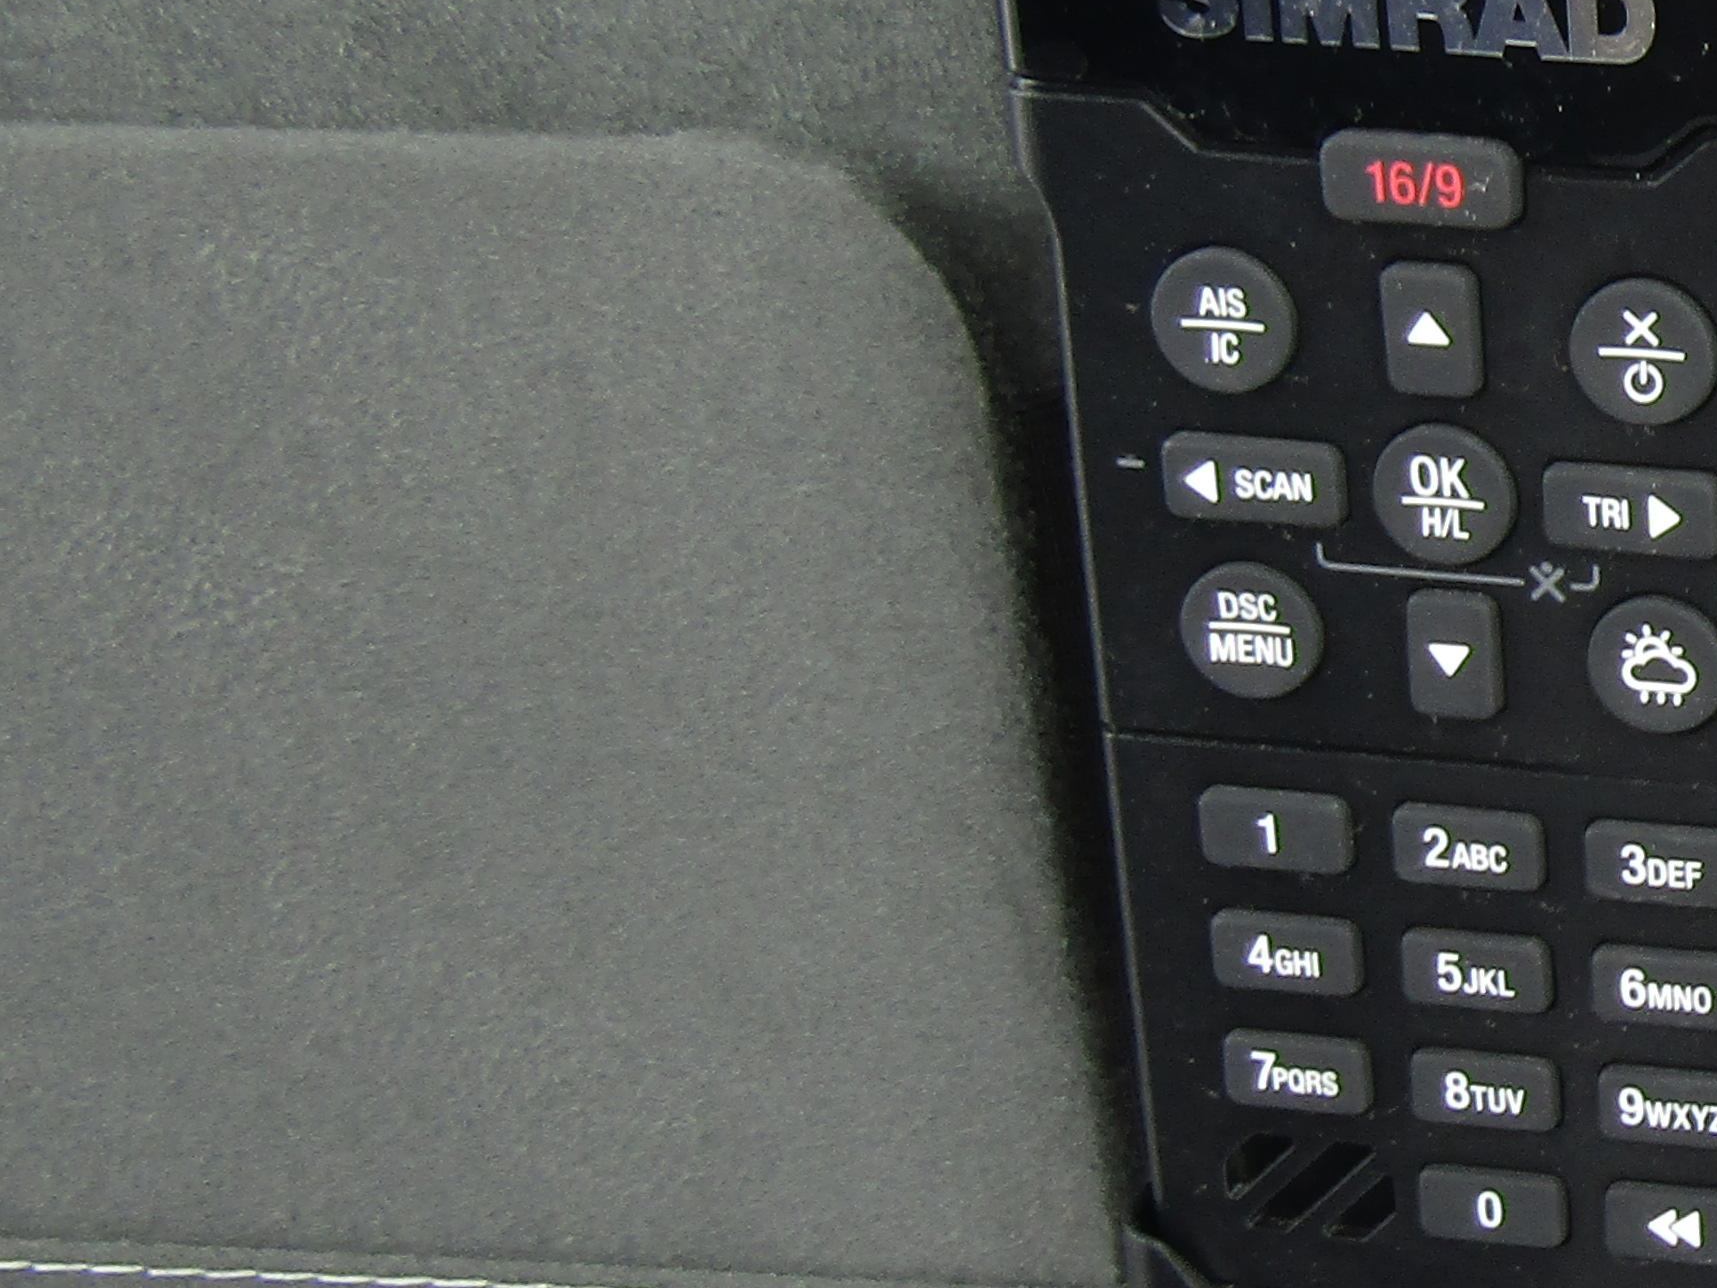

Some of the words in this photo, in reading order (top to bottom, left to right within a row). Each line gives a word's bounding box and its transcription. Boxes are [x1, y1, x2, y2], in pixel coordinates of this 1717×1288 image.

[1366, 159, 1464, 208] 16/9
[1199, 286, 1246, 318] AIS
[1211, 332, 1239, 364] IC
[1234, 469, 1313, 502] SCAN
[1410, 455, 1469, 498] OK
[1421, 507, 1470, 540] H/L
[1582, 495, 1630, 530] TRI
[1217, 592, 1277, 622] DSC
[1210, 633, 1293, 667] MENU
[1256, 813, 1277, 854] 1
[1422, 827, 1508, 874] 2ABC
[1620, 844, 1702, 890] 3DEF
[1247, 934, 1320, 978] 4GHI
[1436, 952, 1515, 998] 5JKL
[1619, 968, 1712, 1015] 6MNO
[1250, 1050, 1339, 1097] 7PQRS
[1444, 1071, 1524, 1115] 8TUV
[1476, 1191, 1503, 1229] 0
